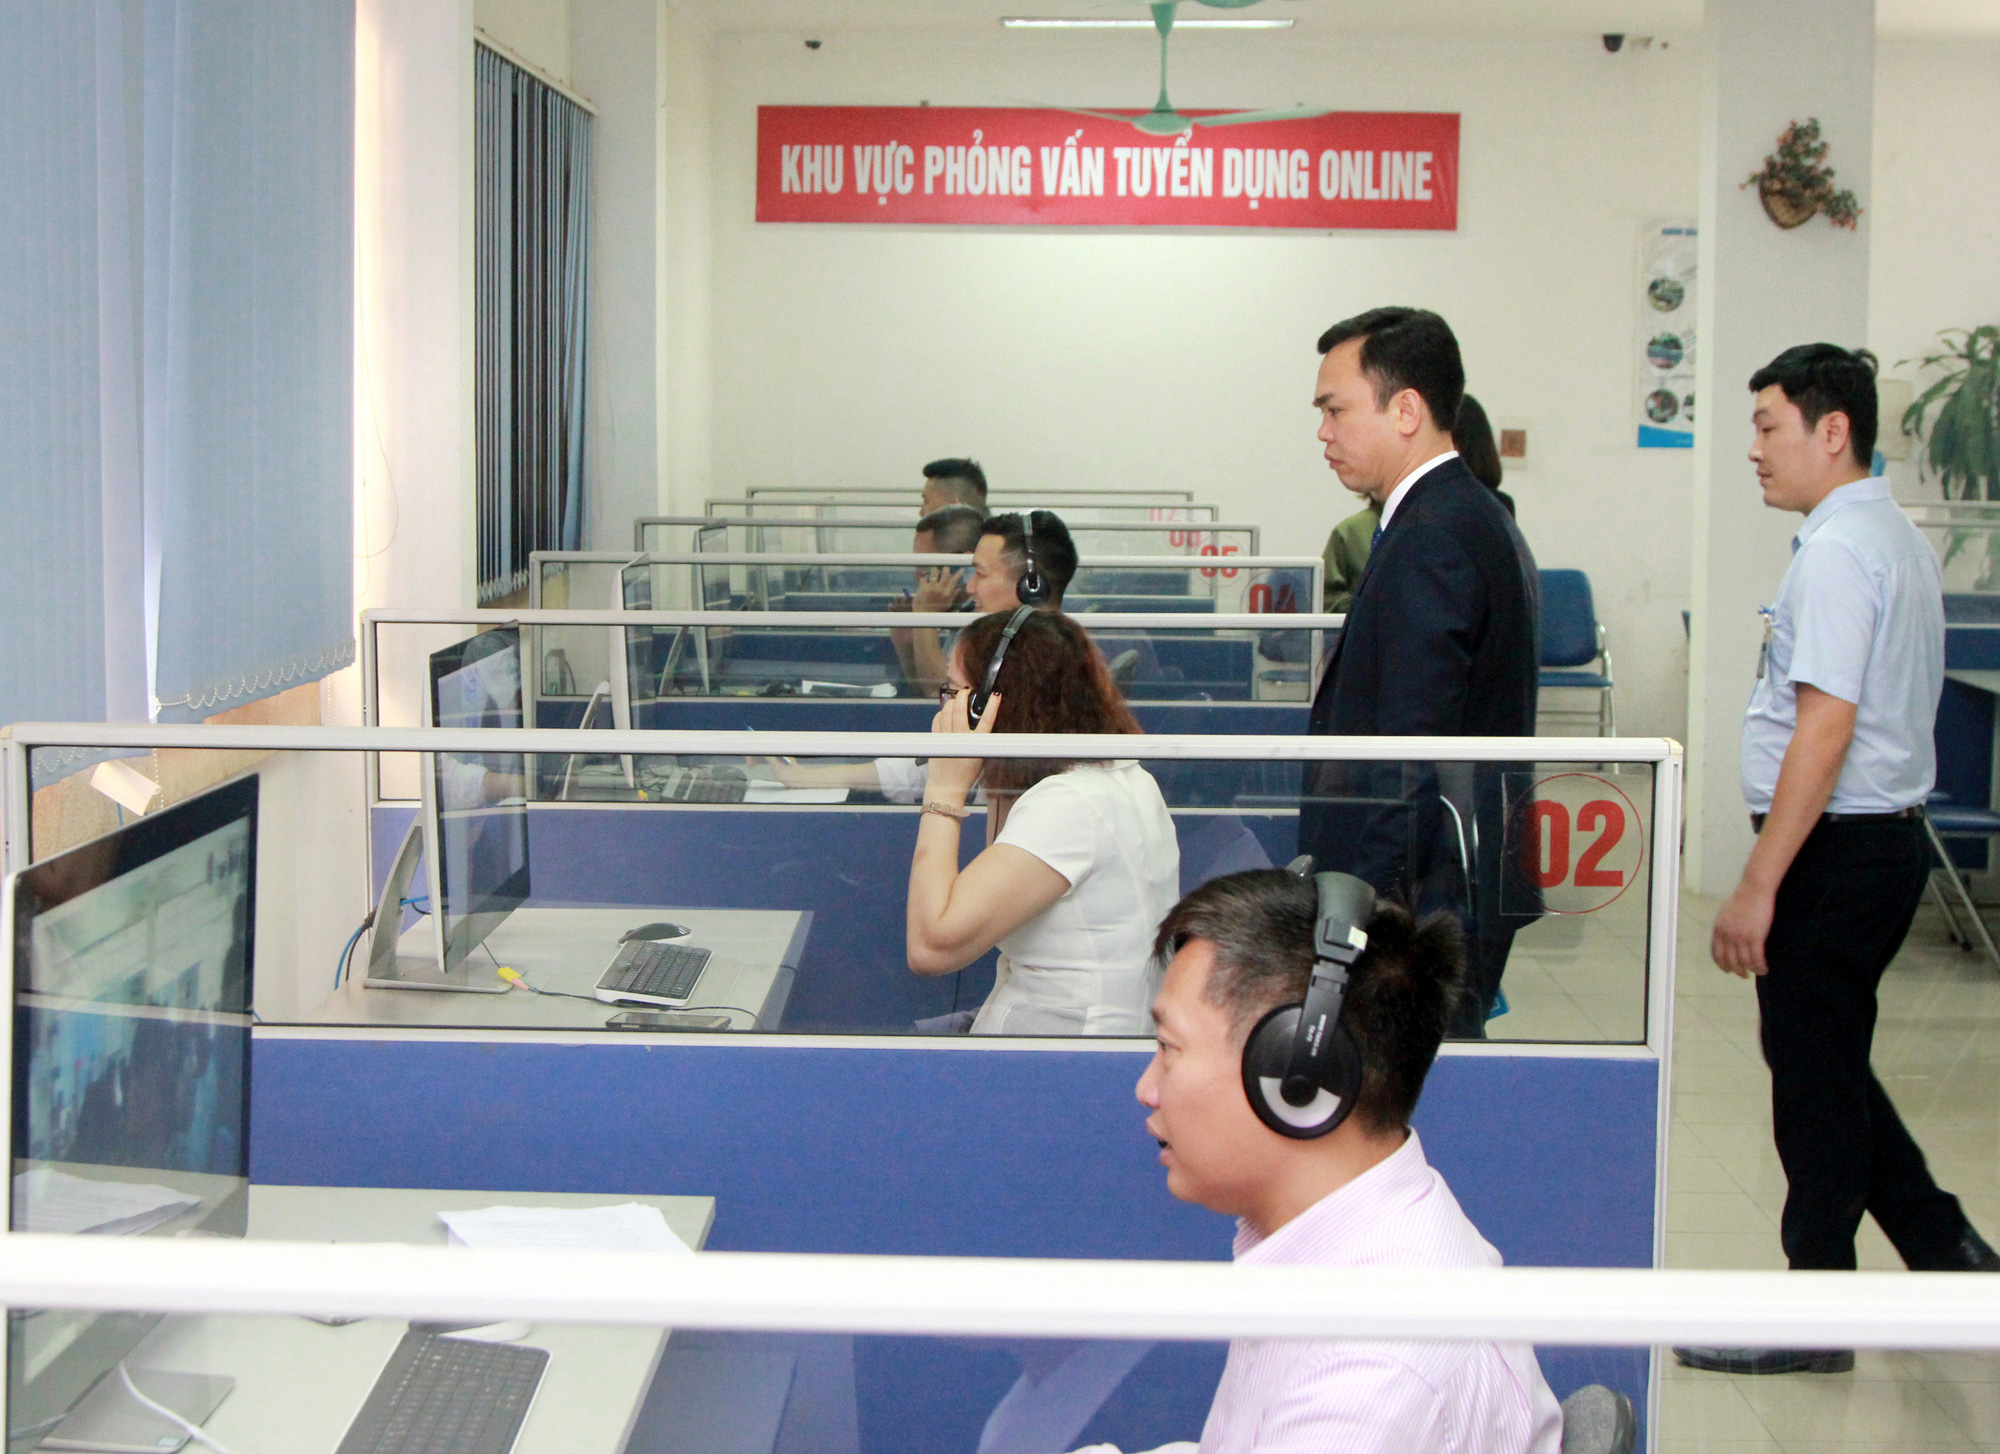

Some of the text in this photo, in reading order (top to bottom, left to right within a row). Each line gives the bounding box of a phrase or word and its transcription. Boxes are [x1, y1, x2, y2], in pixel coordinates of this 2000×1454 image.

[781, 128, 1433, 209] KHU VỰC PHỎNG VẤN TUYỂN DỤNG ONLINE
[1200, 544, 1239, 578] 05
[1519, 799, 1626, 888] 02
